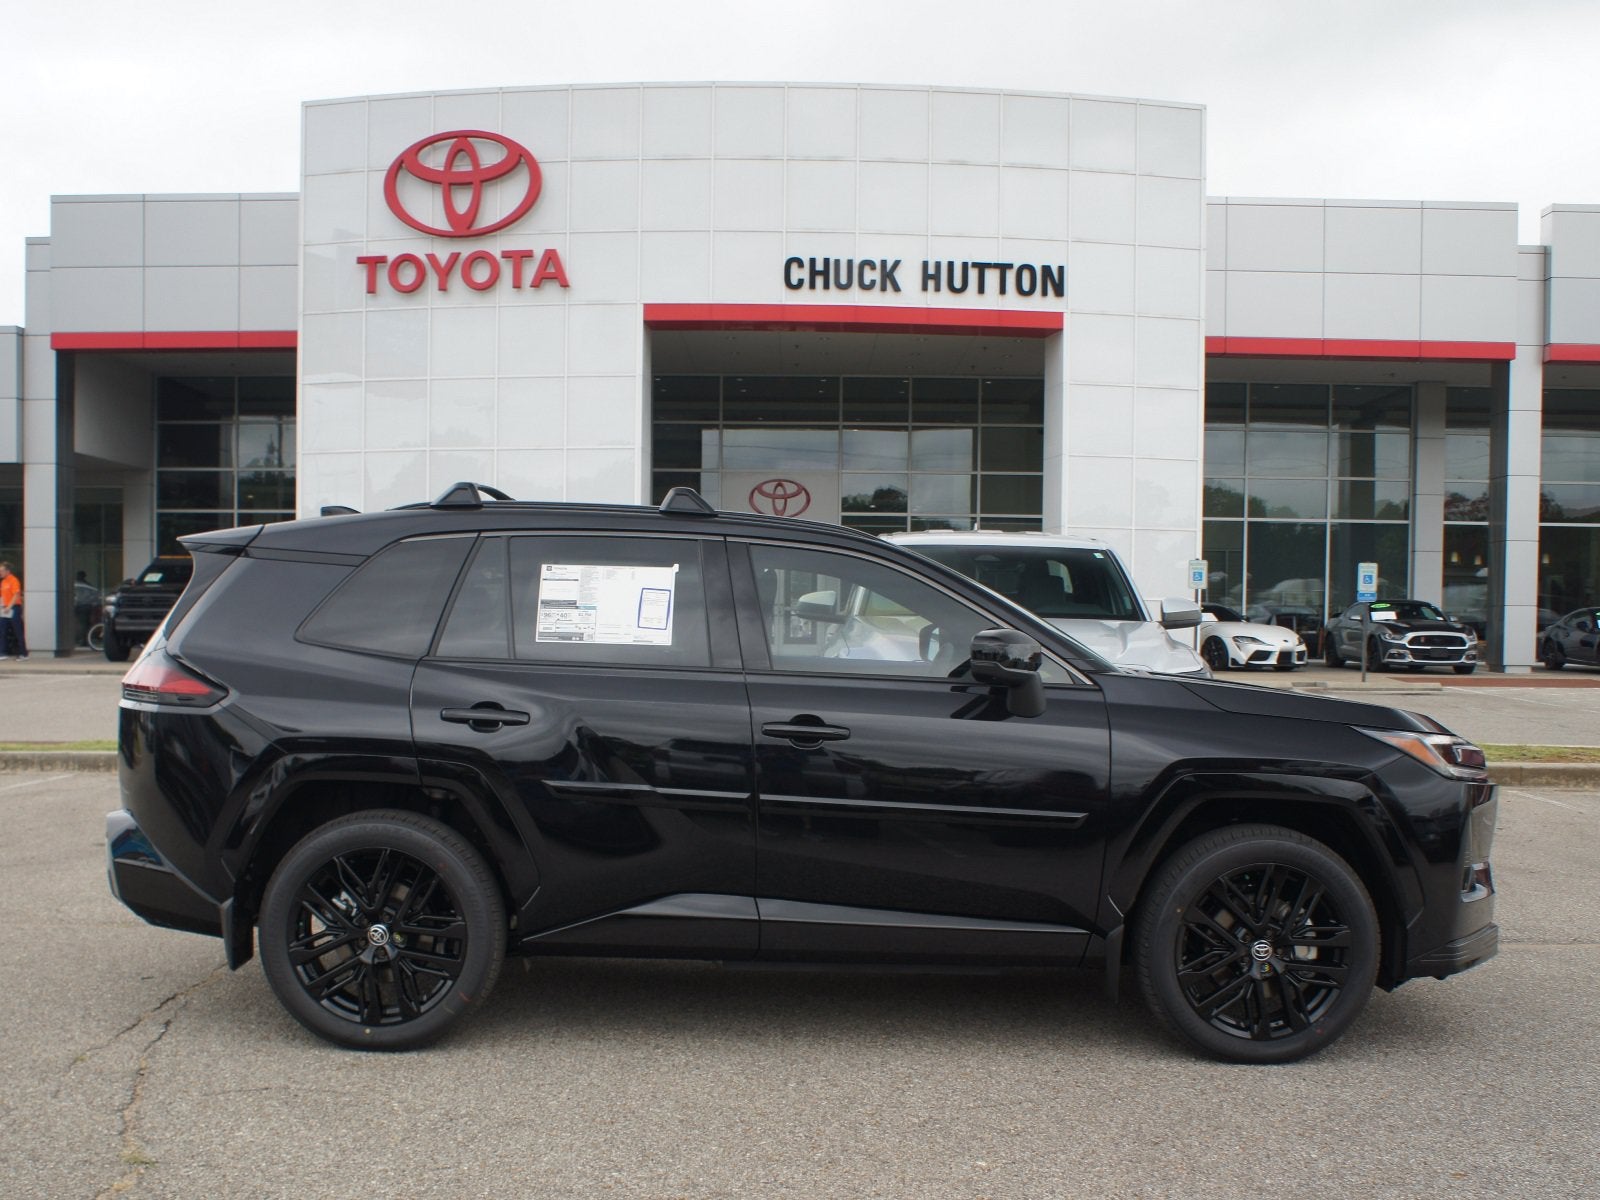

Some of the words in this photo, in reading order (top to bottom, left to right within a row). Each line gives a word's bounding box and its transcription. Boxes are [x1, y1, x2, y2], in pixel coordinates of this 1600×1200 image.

[356, 249, 570, 294] TOYOTA
[784, 256, 902, 292] CHUCK
[921, 259, 1065, 297] HUTTON
